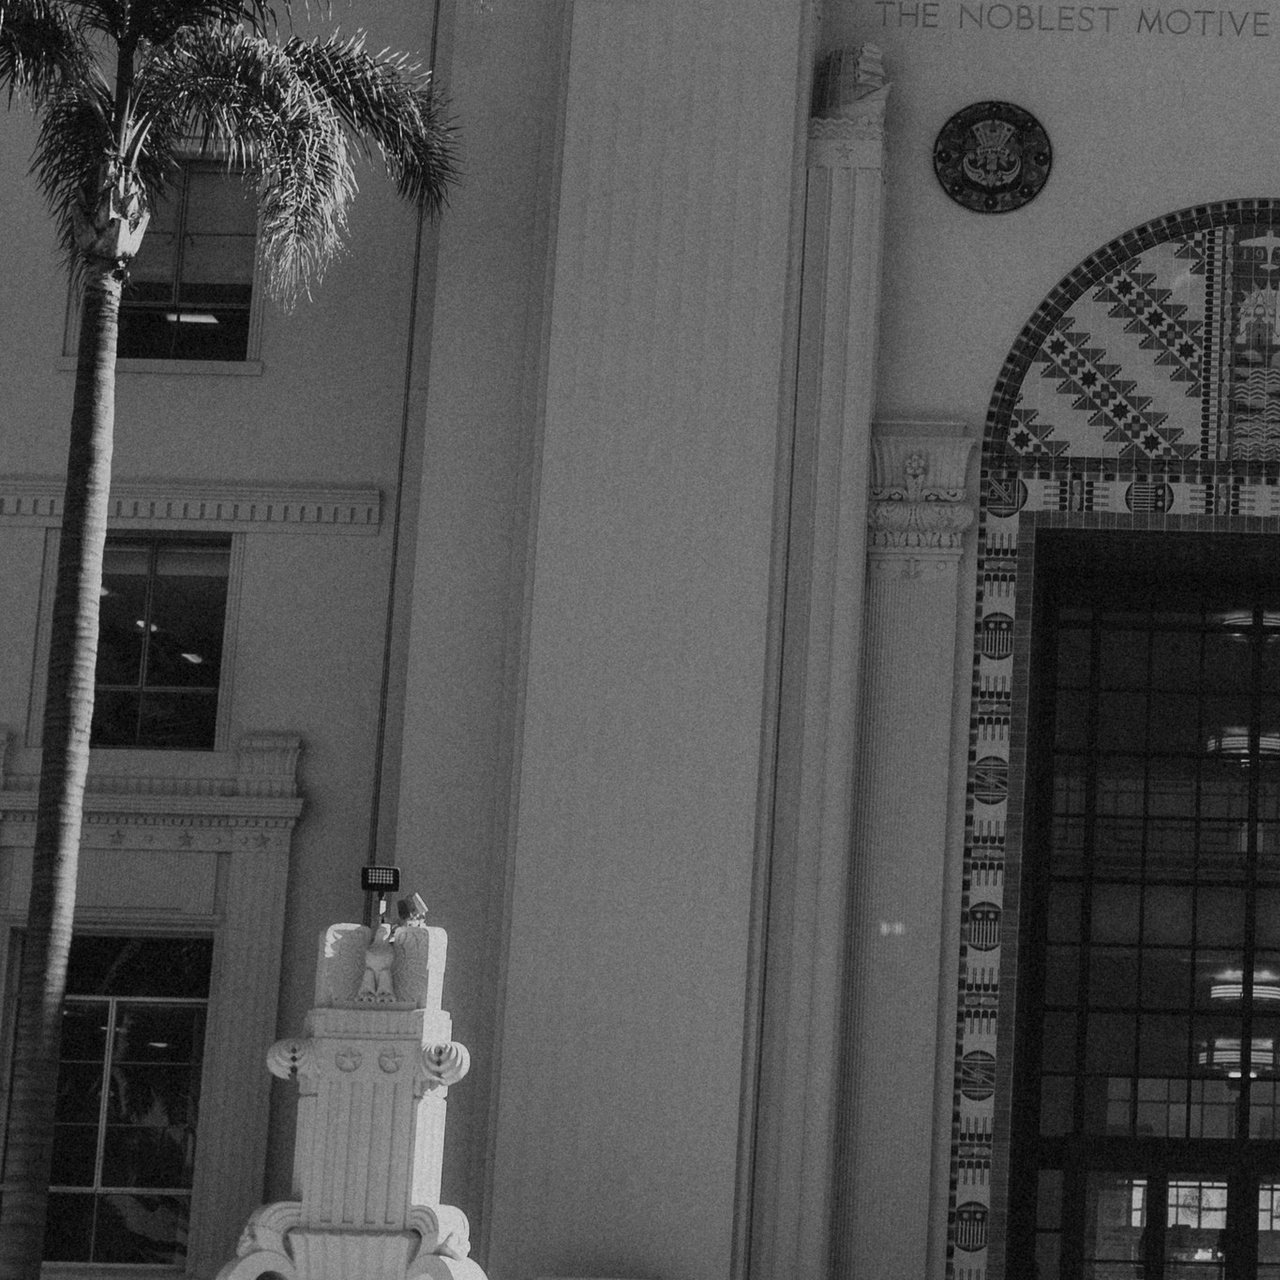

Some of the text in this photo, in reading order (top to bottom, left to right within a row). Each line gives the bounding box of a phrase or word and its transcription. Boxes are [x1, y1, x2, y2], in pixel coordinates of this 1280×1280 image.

[874, 0, 940, 29] THE
[958, 3, 1119, 33] NOBLEST
[1136, 8, 1270, 37] MOTIVE
